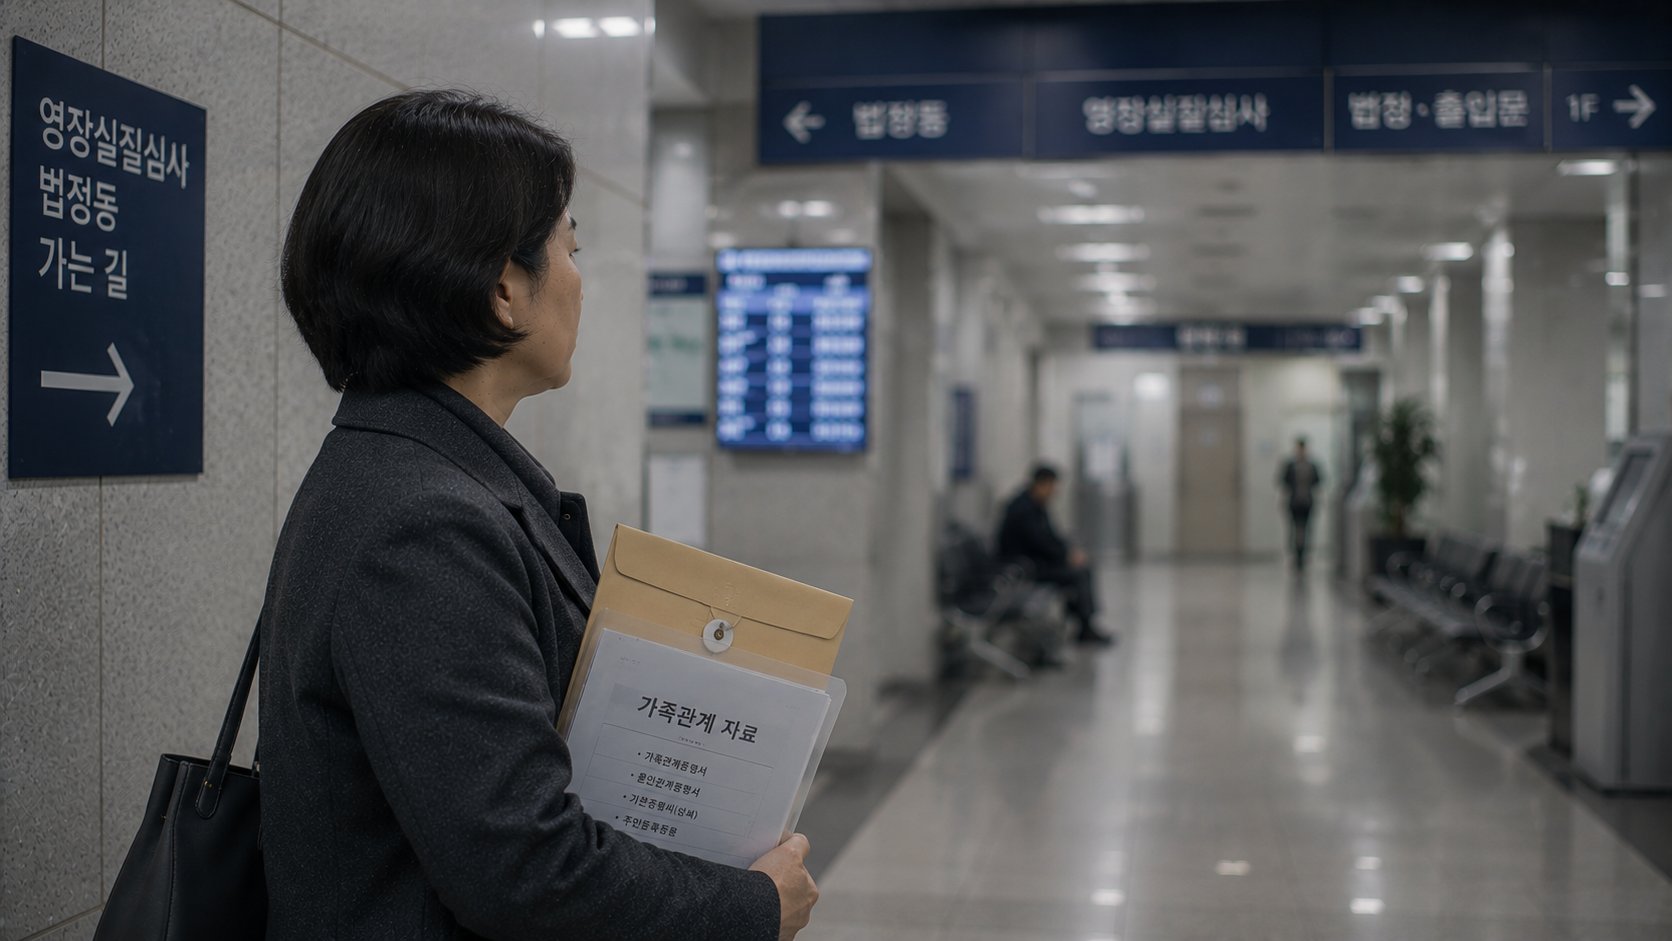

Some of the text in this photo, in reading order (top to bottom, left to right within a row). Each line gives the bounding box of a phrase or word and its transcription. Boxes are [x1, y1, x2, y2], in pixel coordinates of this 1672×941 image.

[1566, 92, 1600, 123] 1F
[39, 96, 189, 189] 영장실질심사
[39, 165, 119, 232] 법정동
[38, 237, 128, 300] 가는 길
[637, 695, 759, 743] 가족관계 자료
